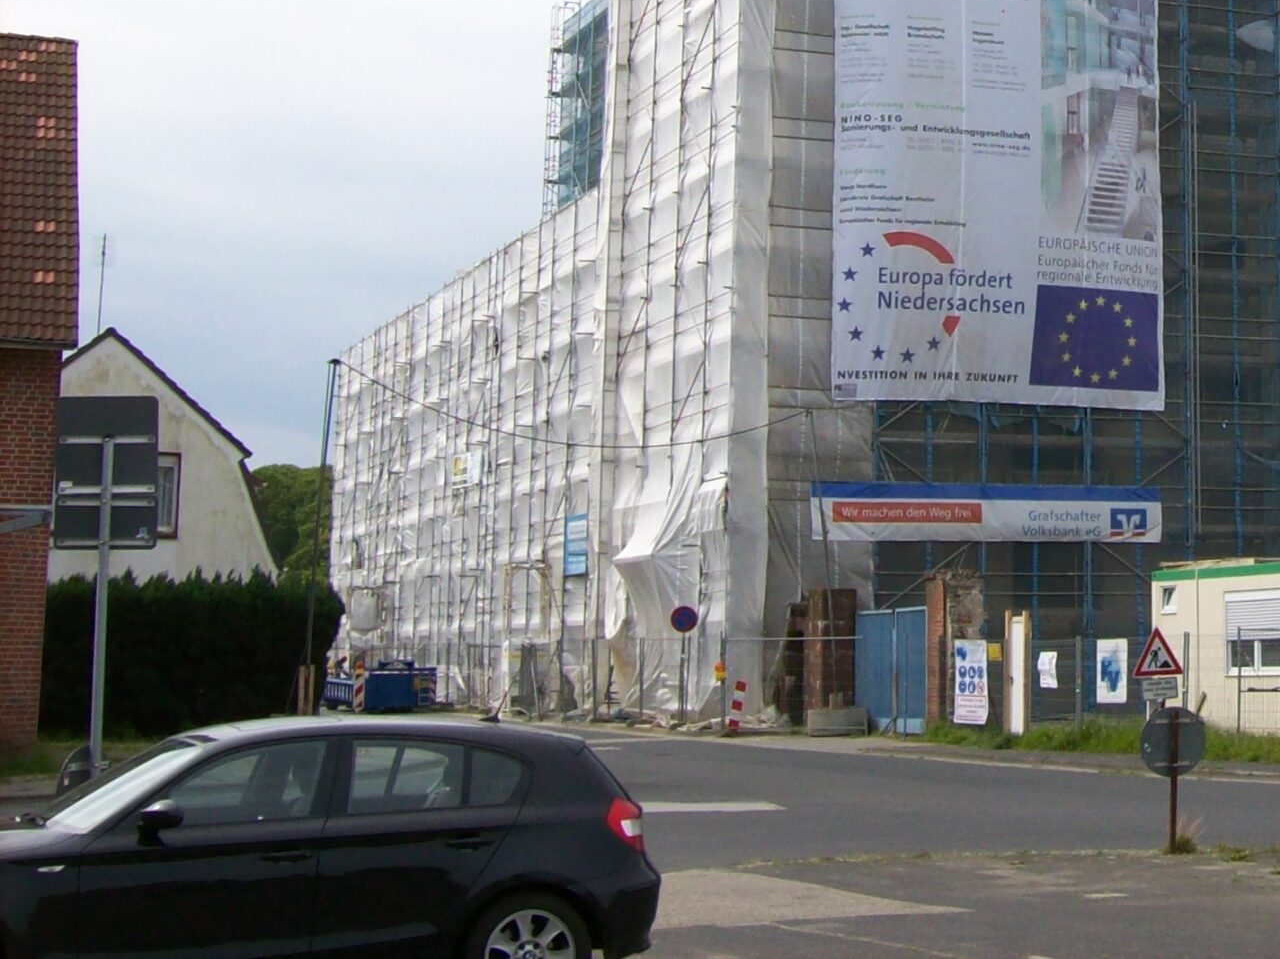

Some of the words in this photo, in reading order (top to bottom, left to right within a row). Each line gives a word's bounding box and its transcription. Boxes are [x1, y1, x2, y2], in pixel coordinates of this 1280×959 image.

[900, 124, 918, 132] und
[1125, 244, 1158, 258] UNION
[1113, 260, 1142, 274] Fonds
[878, 267, 944, 291] Europa
[949, 267, 1013, 289] fördert
[1036, 269, 1092, 283] regionale
[1096, 272, 1158, 291] Entwicklung
[877, 291, 1026, 315] Niedersachsen
[914, 371, 928, 380] IN
[933, 371, 960, 380] IHRE
[966, 372, 1019, 383] ZUKUNFT
[841, 506, 858, 517] Wir
[862, 506, 904, 518] machen
[906, 506, 926, 518] den
[929, 507, 952, 520] Weg
[955, 507, 972, 518] frei
[1028, 510, 1102, 522] Grafschafter
[1022, 525, 1081, 537] Volksbank
[1085, 526, 1102, 537] eG
